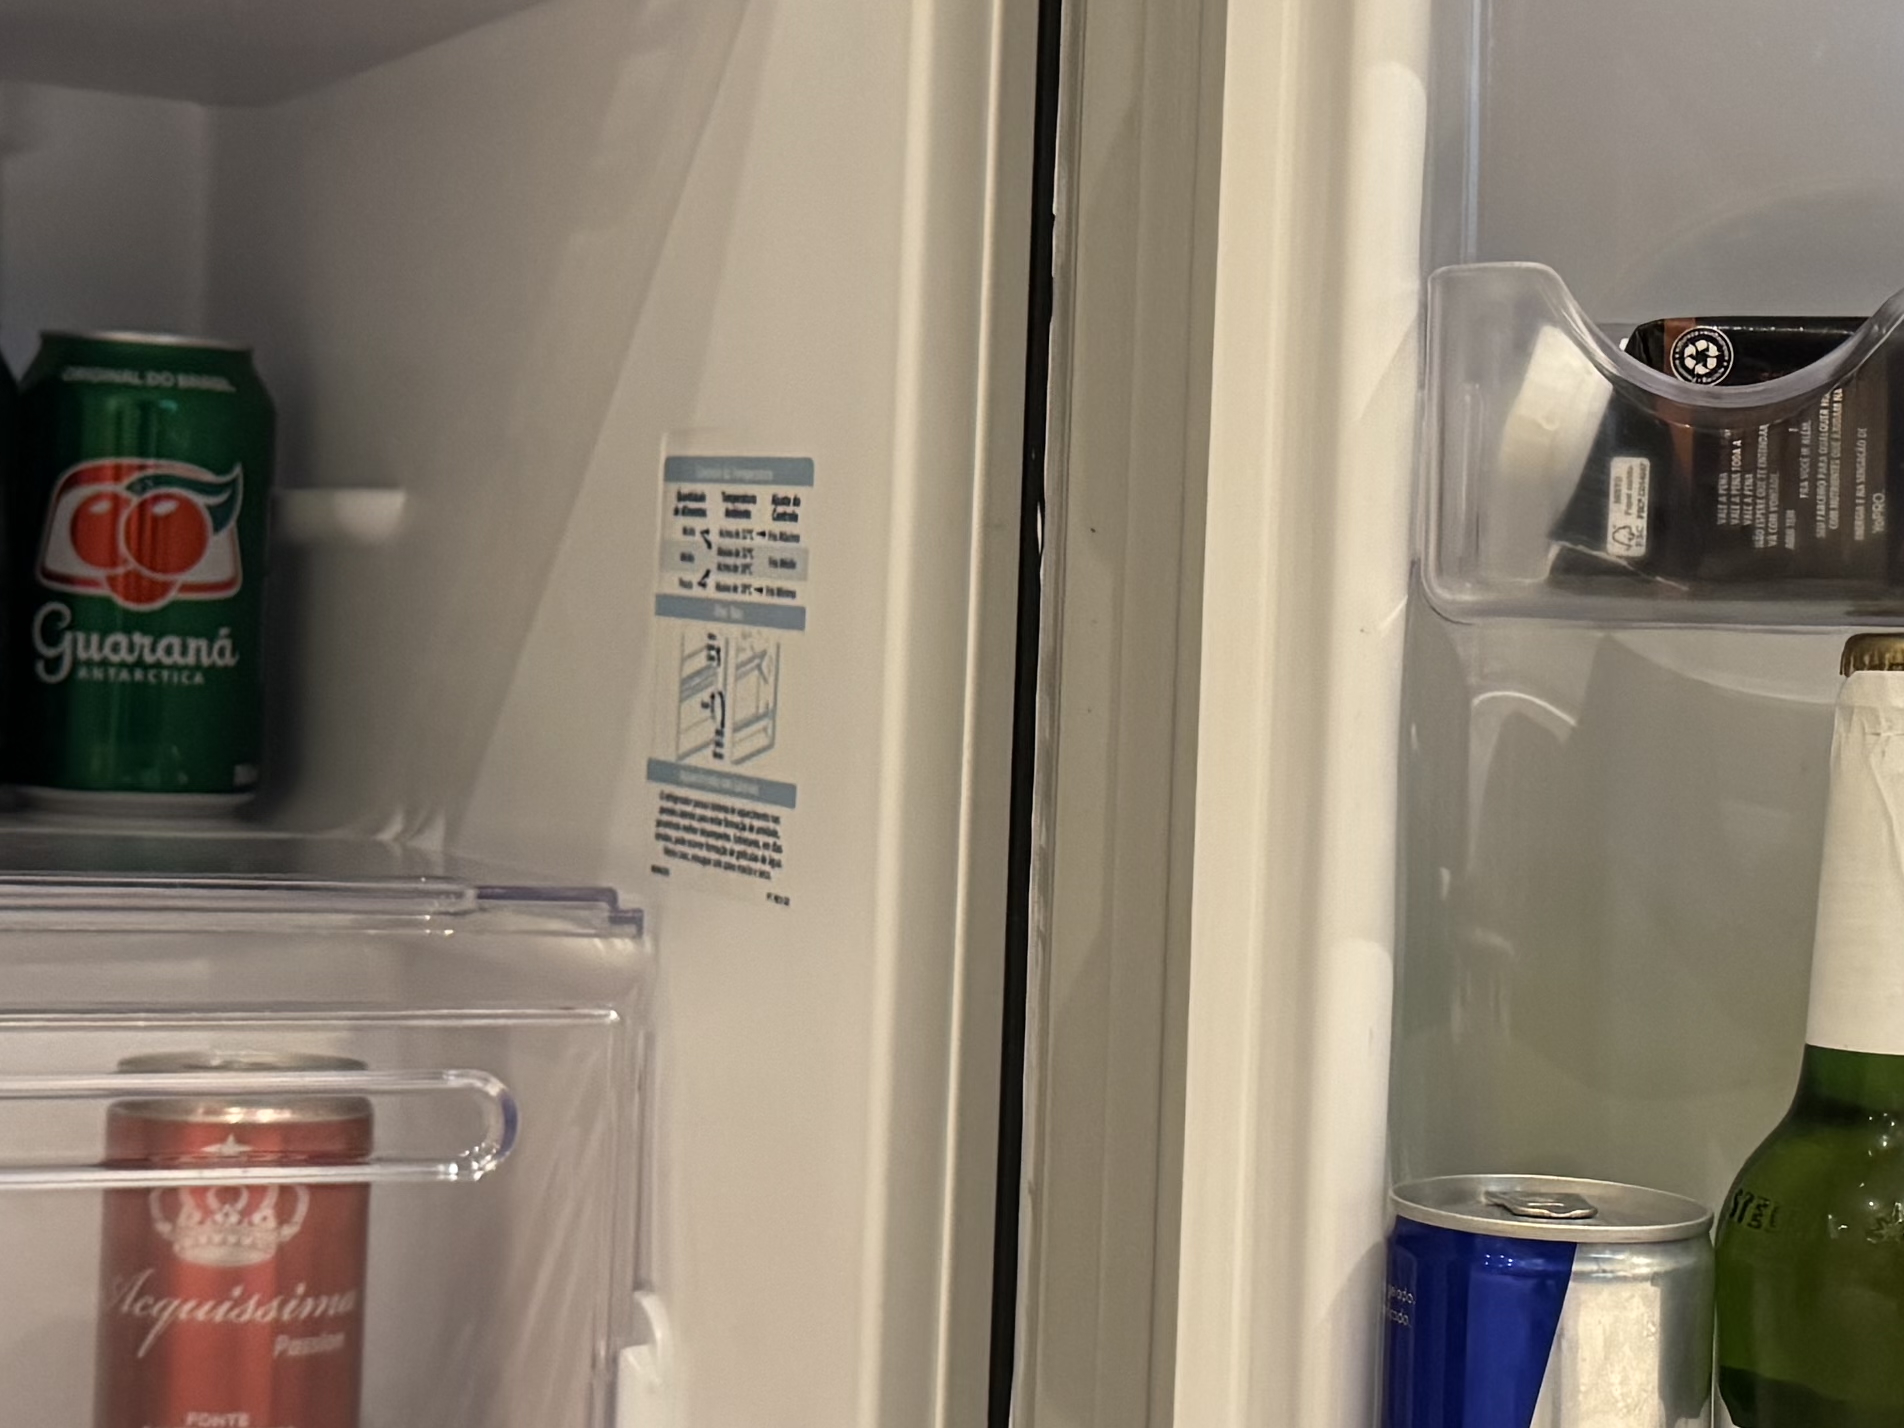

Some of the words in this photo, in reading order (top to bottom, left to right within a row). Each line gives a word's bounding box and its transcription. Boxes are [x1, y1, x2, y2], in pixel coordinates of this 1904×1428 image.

[145, 369, 176, 387] DO
[32, 601, 239, 684] Guaraná
[77, 666, 206, 686] ANTARCTICA
[185, 1411, 250, 1427] FONTE
